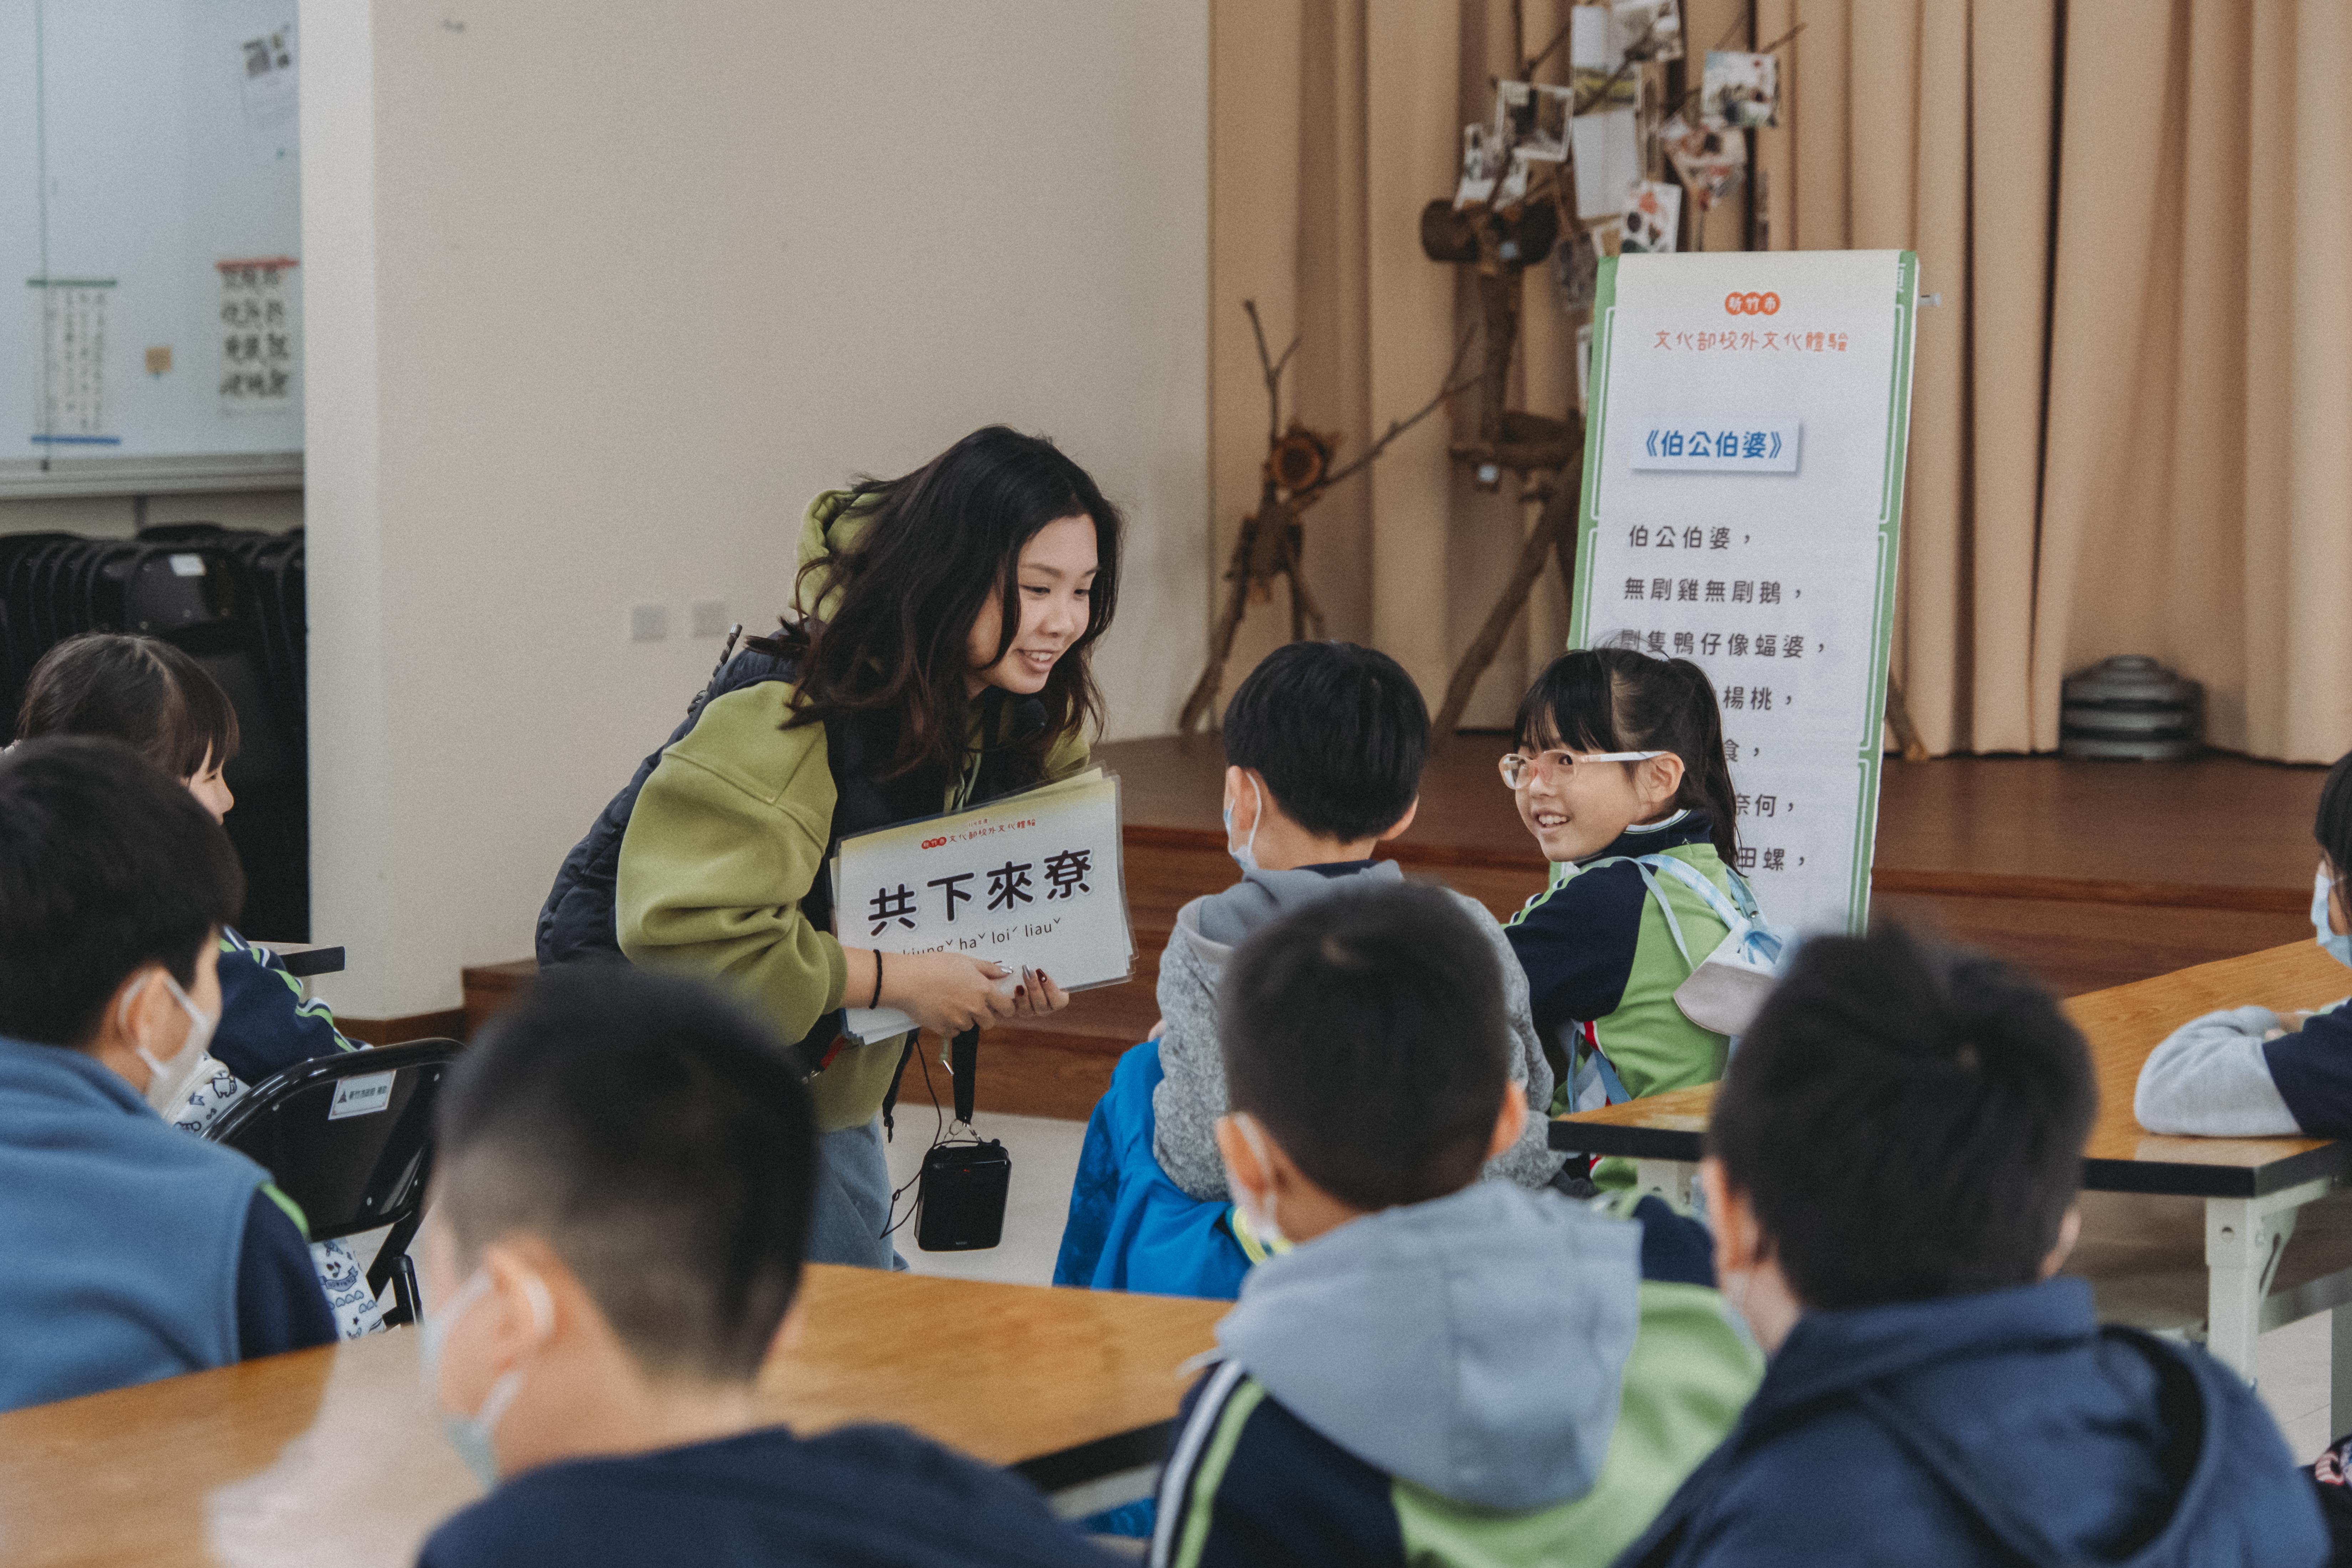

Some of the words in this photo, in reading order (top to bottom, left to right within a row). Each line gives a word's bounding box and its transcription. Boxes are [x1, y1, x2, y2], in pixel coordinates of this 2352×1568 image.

[1727, 295, 1778, 313] 新竹市
[1654, 330, 1849, 351] 文化部校外文化體驗
[1647, 430, 1782, 458] 《伯公伯婆》
[1629, 525, 1750, 549] 伯公伯婆，
[949, 819, 1035, 843] 文化部校外文化體驗
